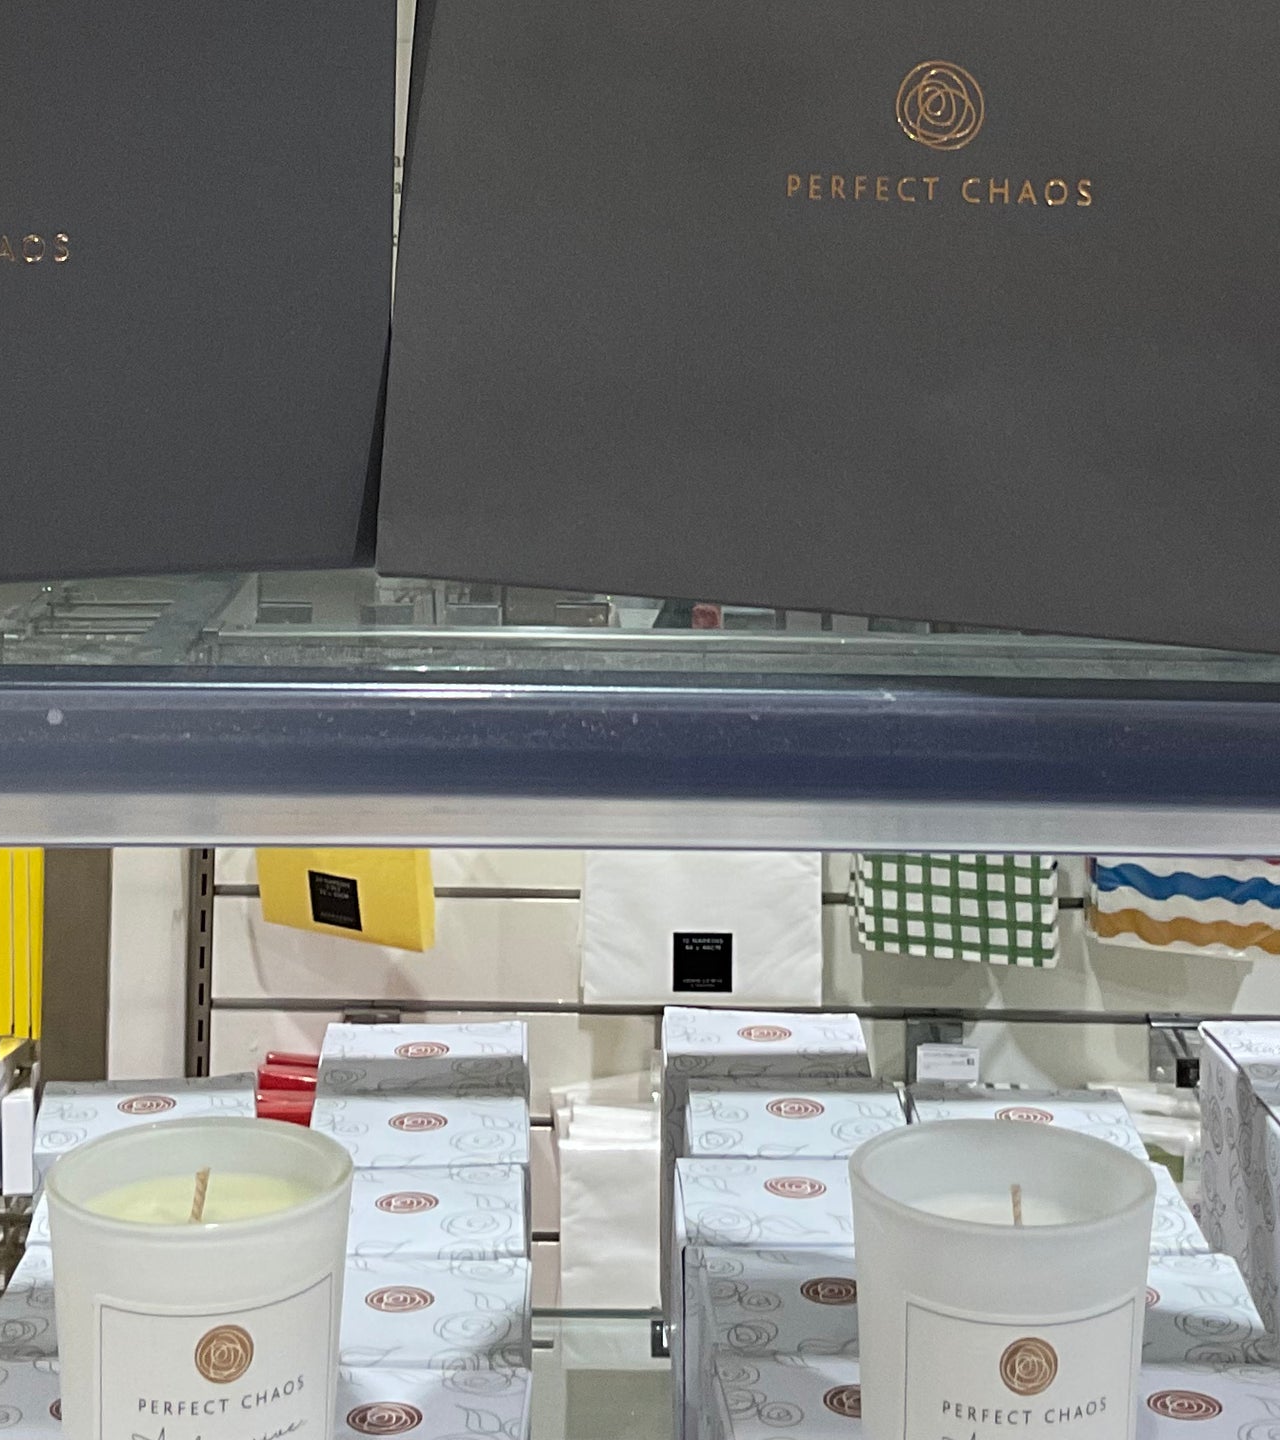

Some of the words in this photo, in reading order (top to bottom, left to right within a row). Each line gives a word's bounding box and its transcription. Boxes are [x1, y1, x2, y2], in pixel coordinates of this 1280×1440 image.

[785, 173, 941, 202] PERFECT
[961, 176, 1094, 207] CHAOS
[137, 1398, 230, 1417] PERFECT
[240, 1374, 305, 1410] CHAOS
[942, 1399, 1033, 1426] PERFECT
[1044, 1396, 1108, 1425] CHAOS
